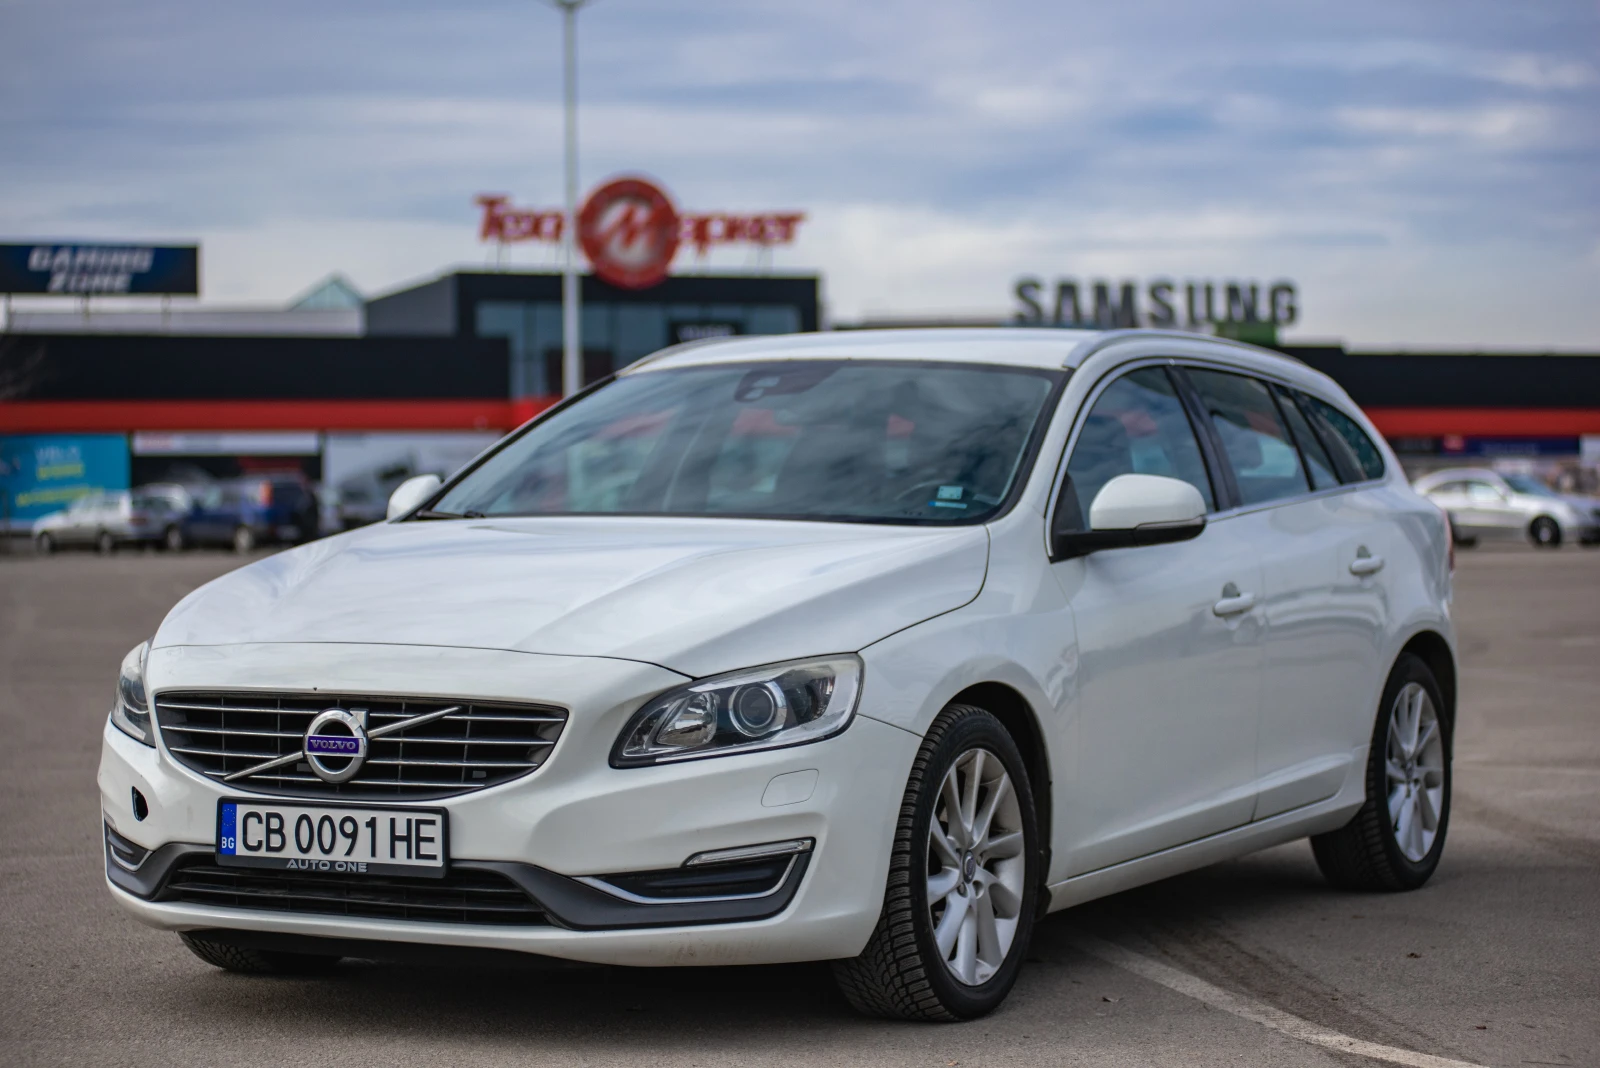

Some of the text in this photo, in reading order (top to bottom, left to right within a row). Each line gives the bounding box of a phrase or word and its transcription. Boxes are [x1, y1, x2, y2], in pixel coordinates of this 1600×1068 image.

[28, 245, 155, 272] GAMING
[49, 271, 132, 292] ZONE
[1012, 278, 1298, 328] SAMSUNG
[310, 739, 356, 750] VOLVO
[221, 836, 235, 849] BG
[242, 811, 438, 861] CB 0091 HE
[286, 858, 368, 873] AUTO ONE
